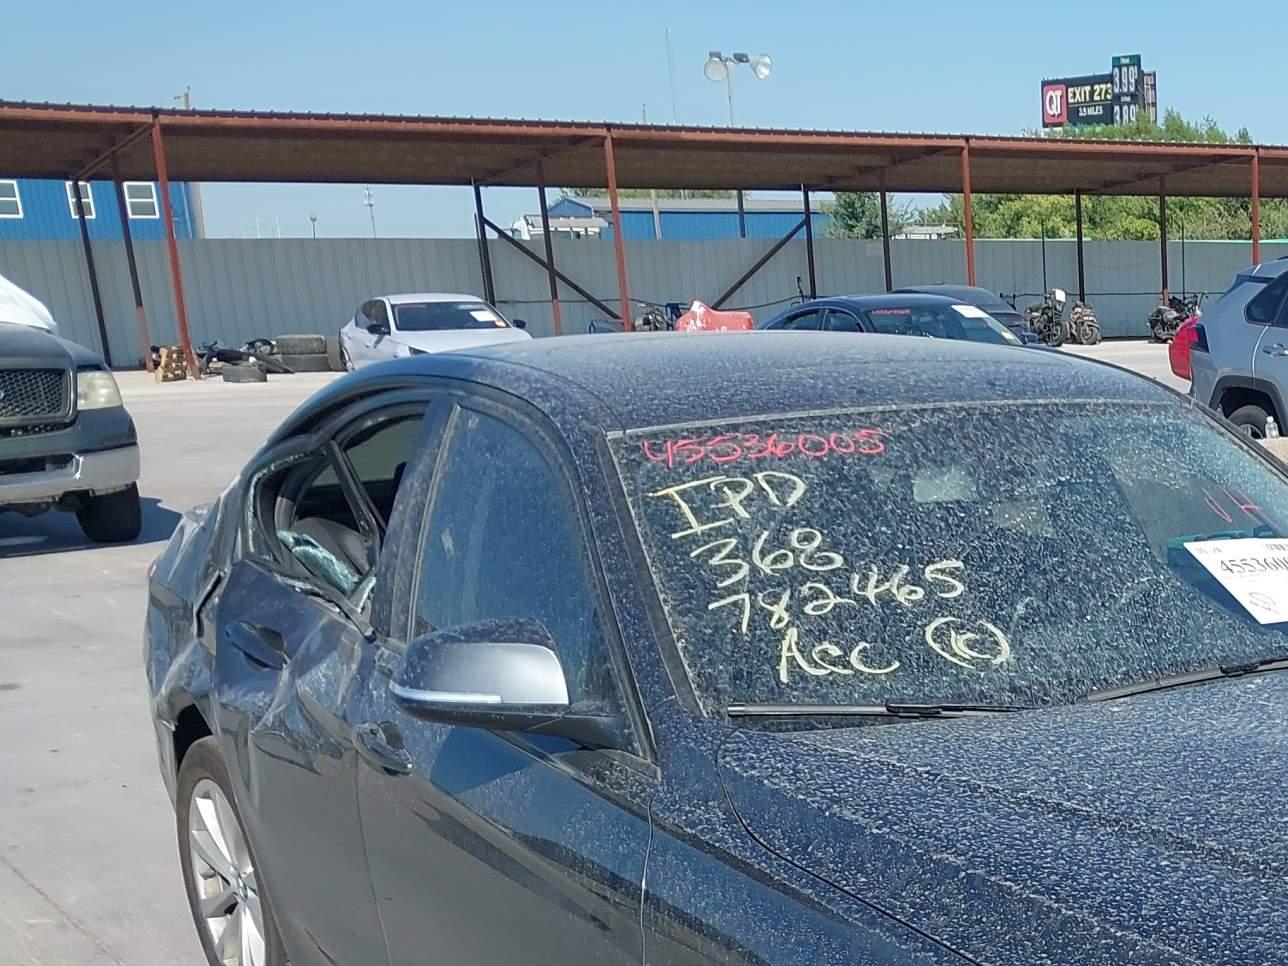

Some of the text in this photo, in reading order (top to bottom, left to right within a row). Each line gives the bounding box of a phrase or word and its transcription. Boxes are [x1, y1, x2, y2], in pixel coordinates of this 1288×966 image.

[1045, 90, 1064, 116] QT
[1067, 83, 1112, 104] EXIT 273
[641, 428, 890, 470] 45536005
[689, 527, 845, 588] 368
[707, 558, 966, 635] 782465
